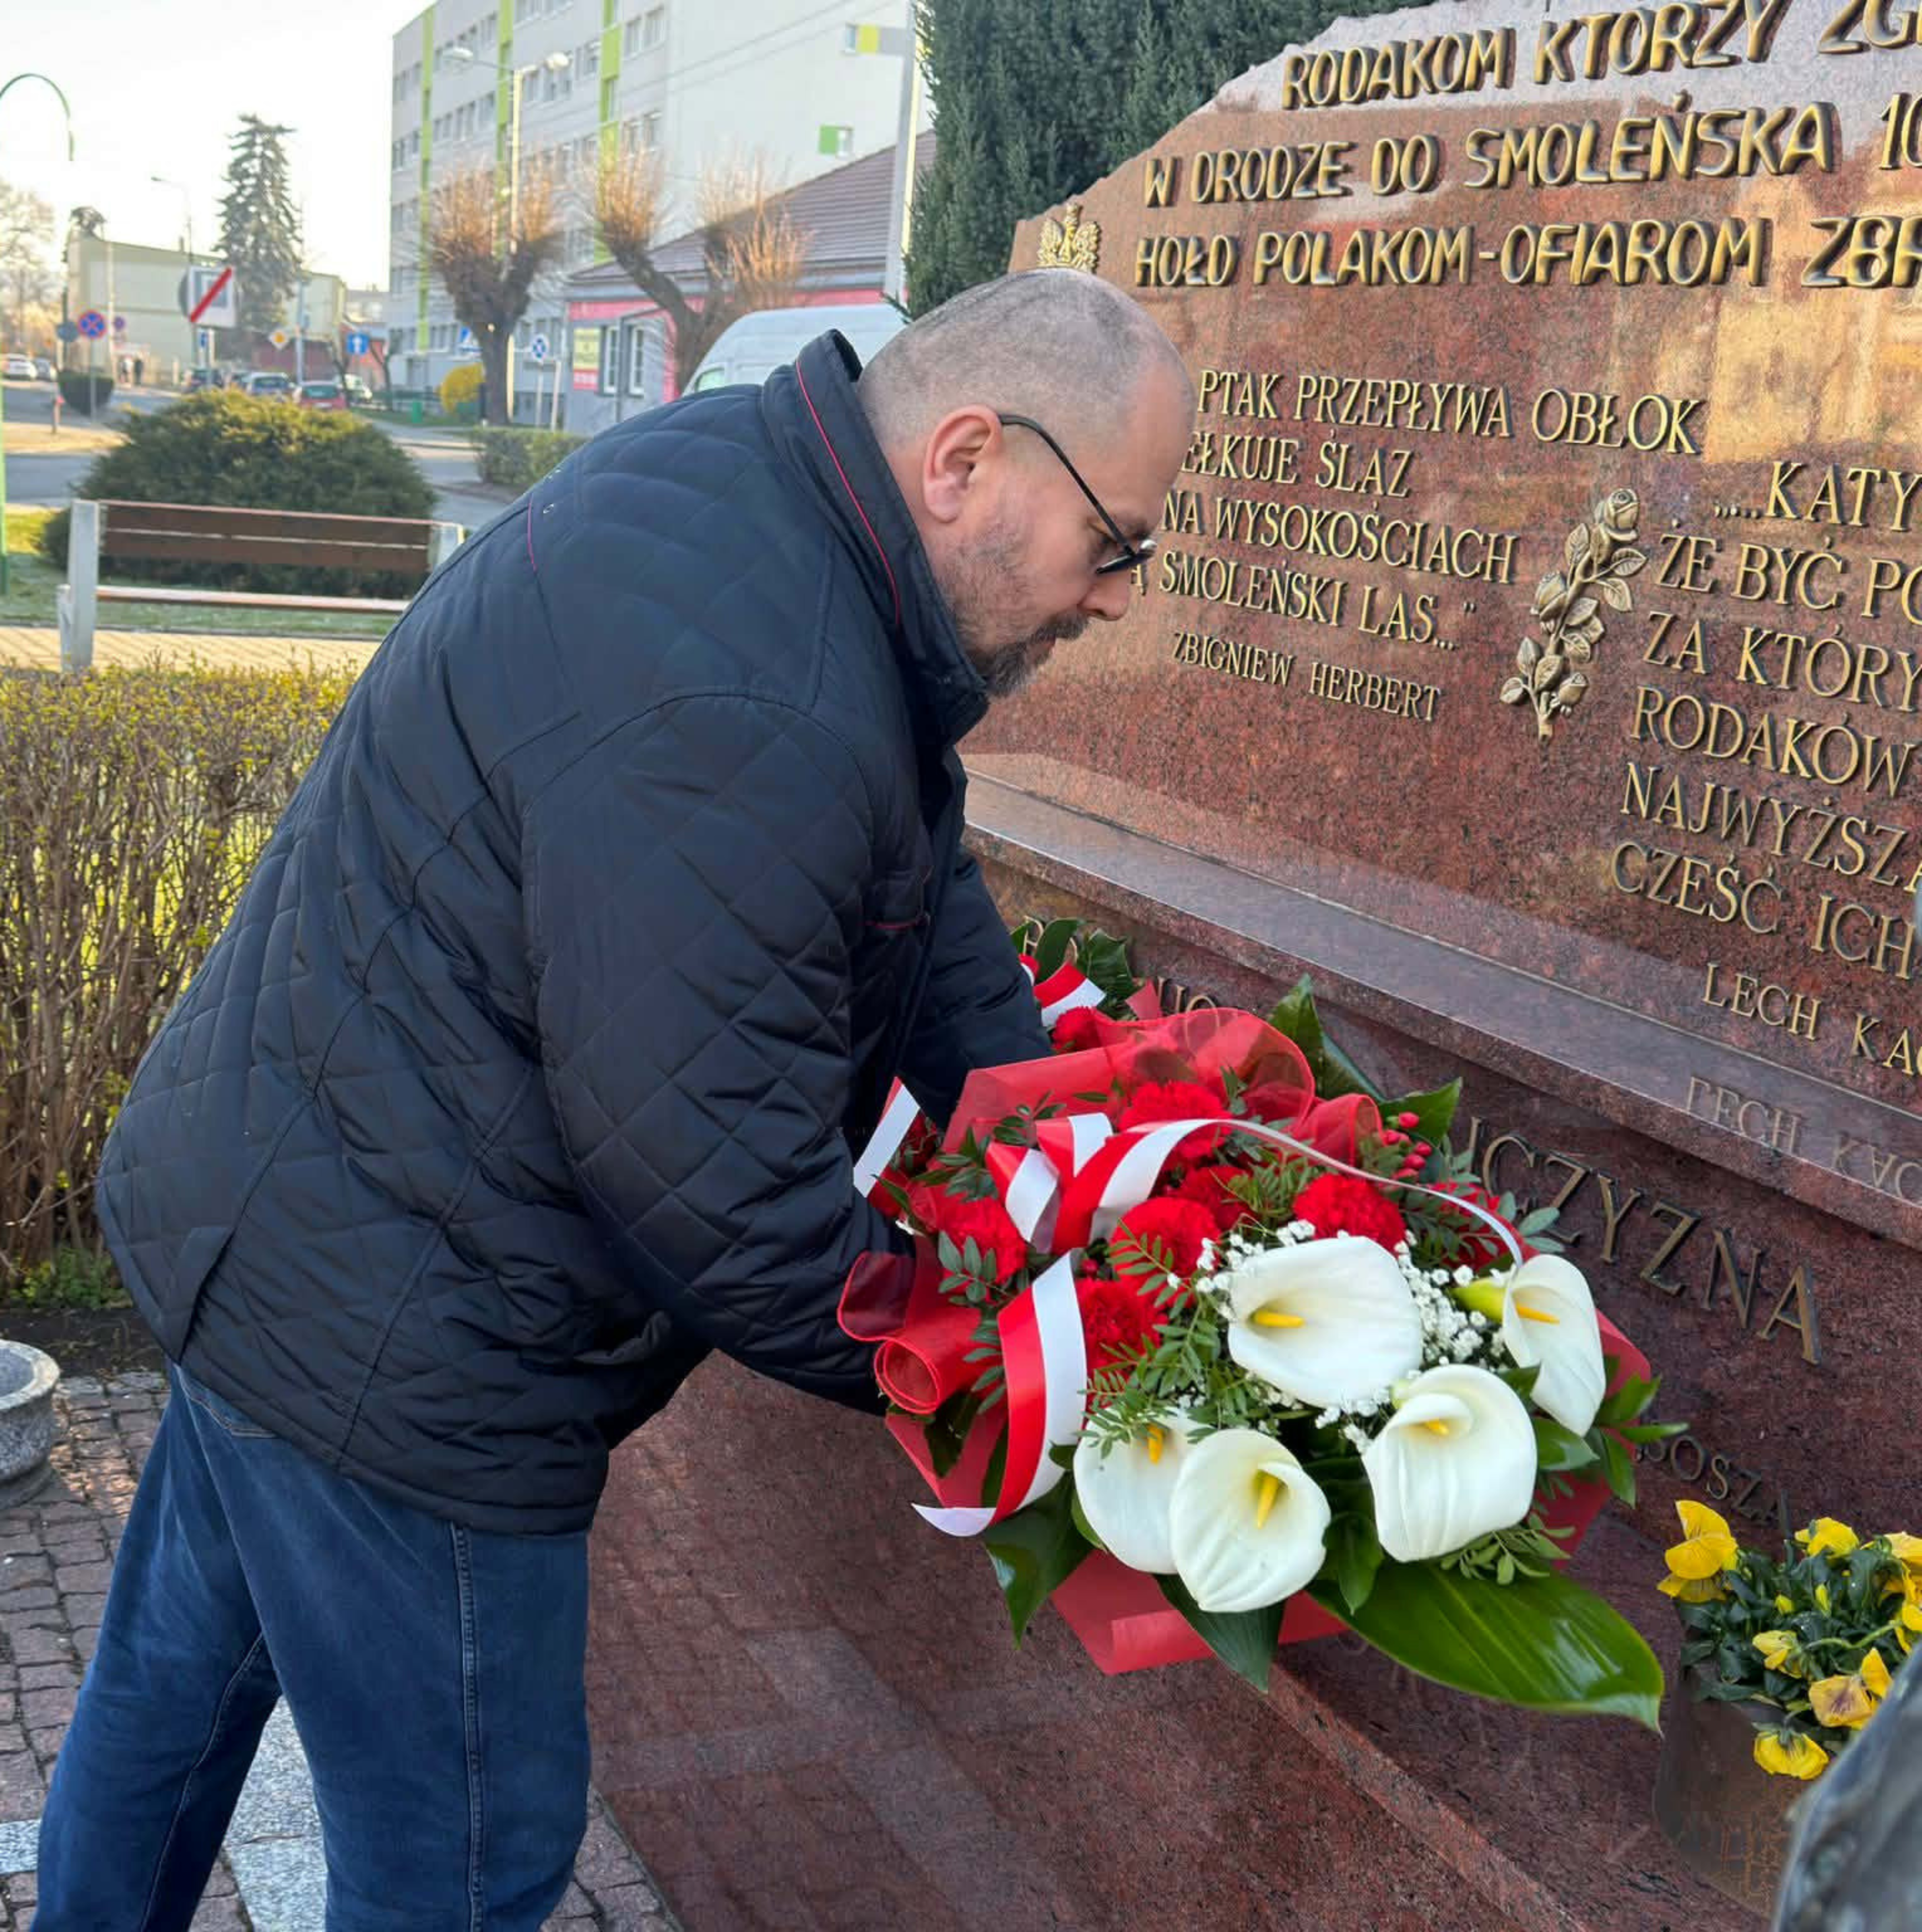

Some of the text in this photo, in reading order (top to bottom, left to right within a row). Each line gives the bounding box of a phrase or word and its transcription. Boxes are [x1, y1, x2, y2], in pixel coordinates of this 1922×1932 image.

[1282, 27, 1517, 110] RODAKOM
[1817, 0, 1922, 54] ZG
[1145, 157, 1182, 207] W
[1190, 141, 1356, 203] DRODZE
[1371, 135, 1440, 195] DO
[1464, 90, 1837, 189] SMOLEŃSKA
[1135, 234, 1238, 287] HOŁD
[1197, 369, 1700, 454] PTAK PRZEPŁYWA OBŁOK
[1315, 429, 1414, 497] ŚLAZ
[1161, 490, 1202, 535] NA
[1215, 497, 1517, 584] WYSOKOŚCIACH
[1656, 518, 1718, 593] ŻE
[1730, 536, 1844, 610] BYĆ
[1159, 550, 1347, 626] SMOLEŃSKI
[1173, 631, 1441, 721] ZBIGNIEW HERBERT
[1643, 610, 1922, 712] ZA KTÓRY
[1630, 685, 1917, 797] RODAKÓW
[1612, 841, 1916, 980] CZEŚĆ ICH
[1703, 962, 1922, 1076] LECH KA
